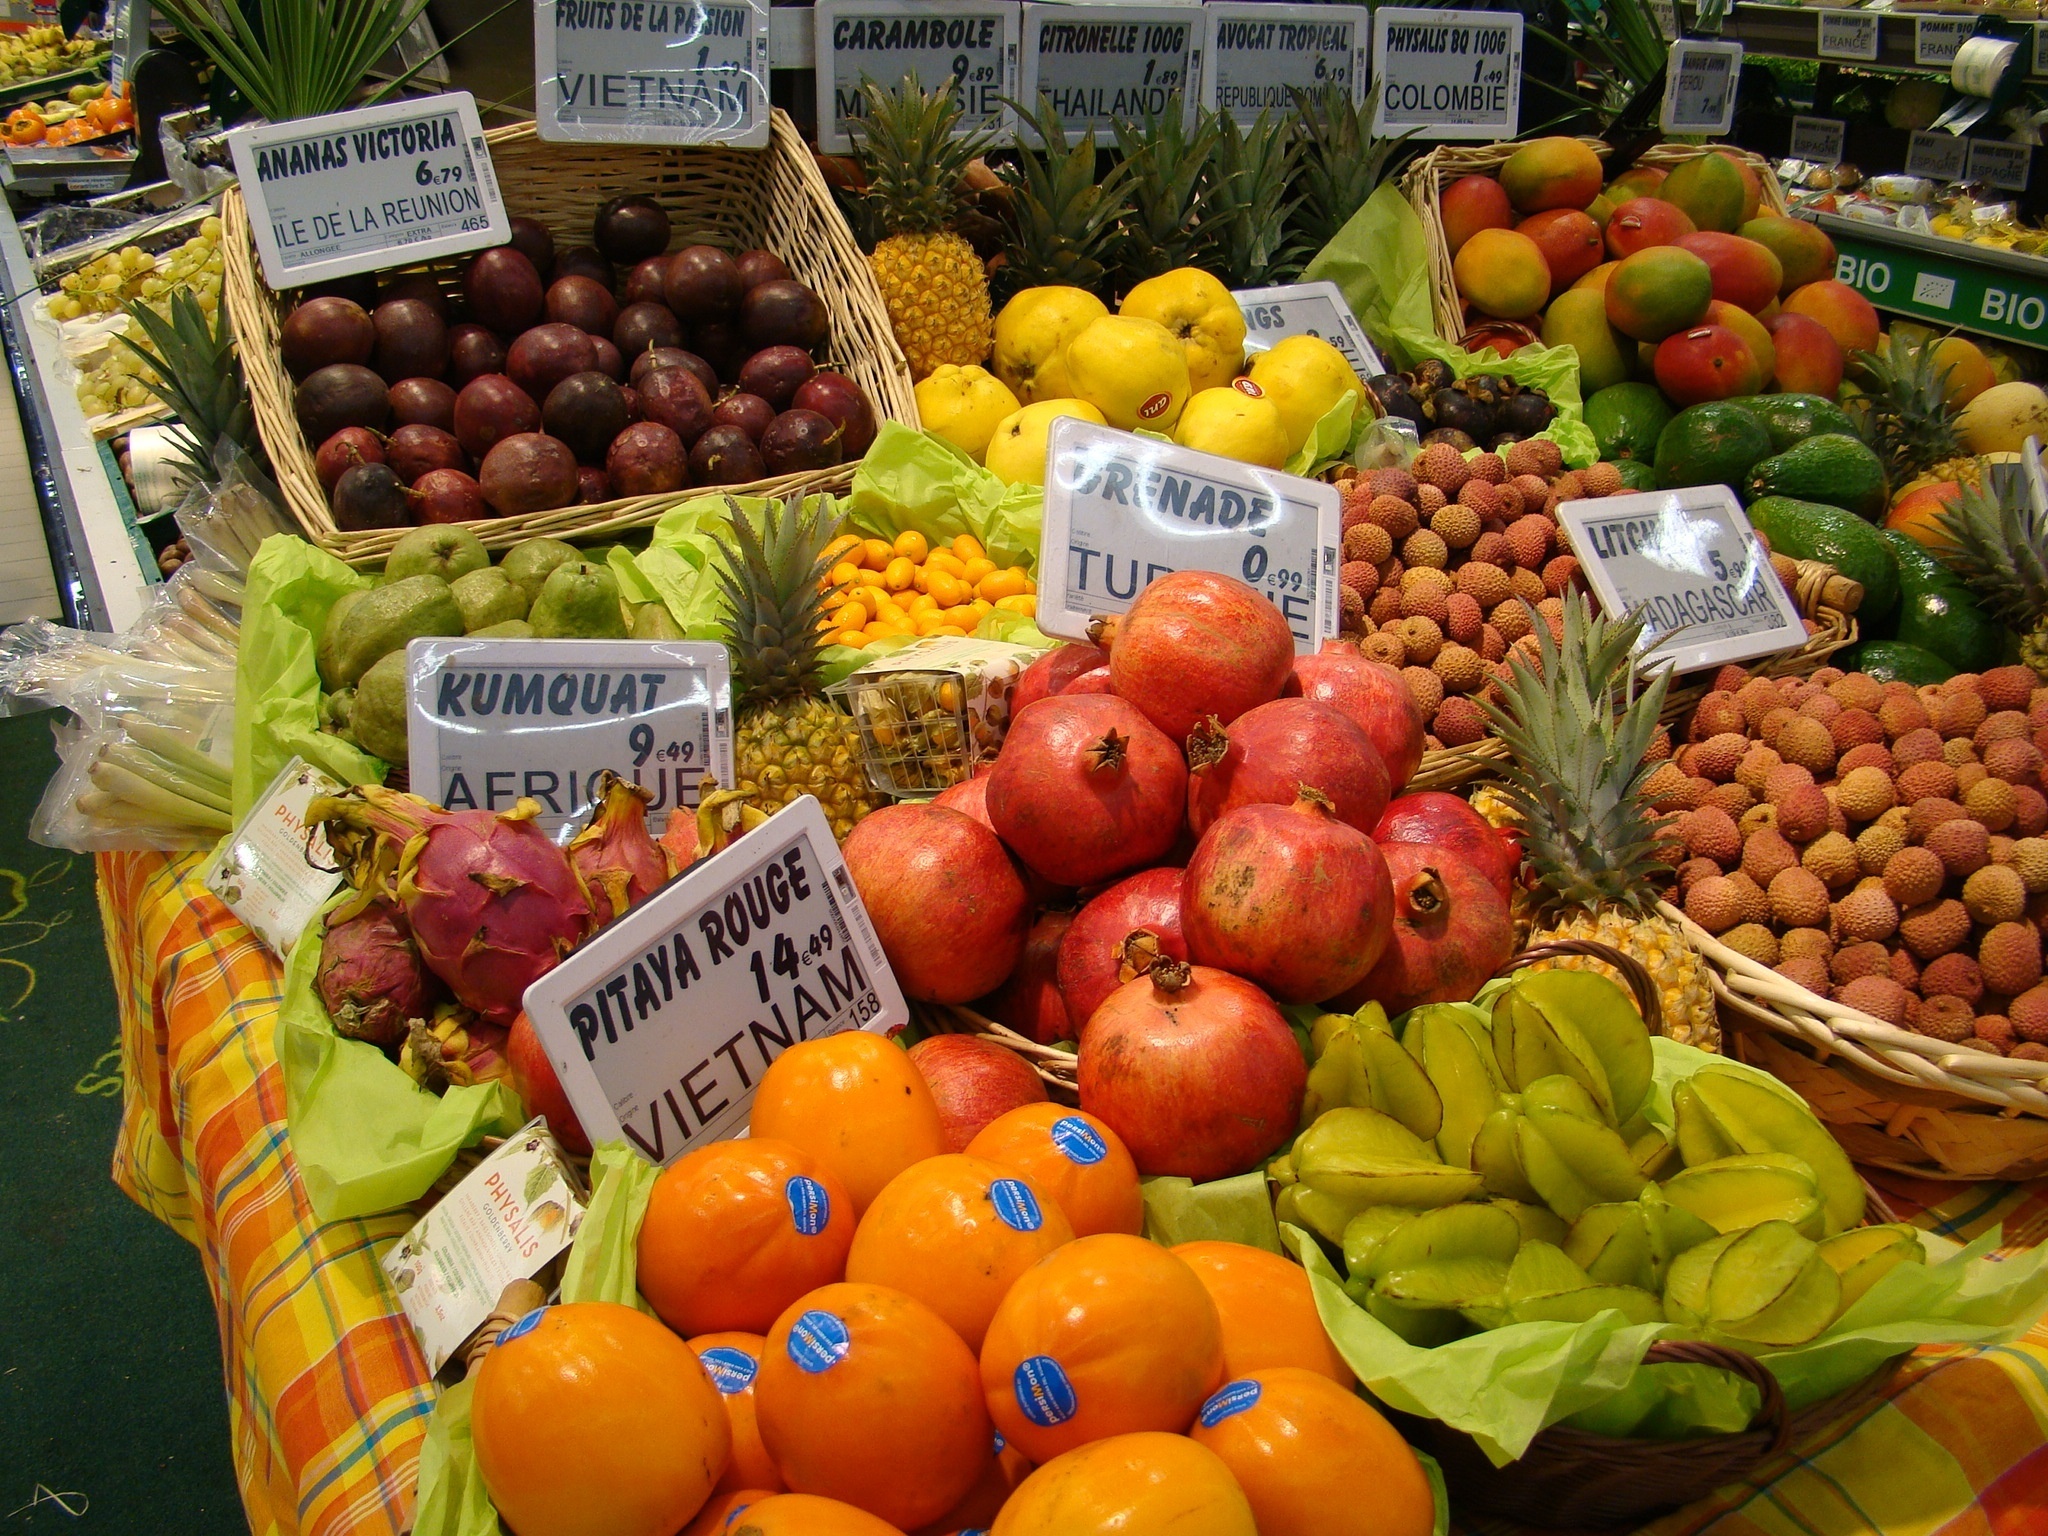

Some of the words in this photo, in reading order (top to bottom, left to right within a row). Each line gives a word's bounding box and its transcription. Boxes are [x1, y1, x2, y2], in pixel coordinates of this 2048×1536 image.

[556, 0, 616, 30] FRUITS
[620, 3, 644, 31] DE
[649, 5, 669, 33] LA
[674, 6, 745, 37] PASION
[833, 19, 996, 50] CARAMBOLE
[1920, 22, 1956, 33] POMME
[1957, 23, 1974, 34] BIO
[1039, 24, 1138, 53] CITRONELLE
[1141, 26, 1184, 54] 100G
[1217, 22, 1275, 51] AVOCAT
[1278, 24, 1347, 51] TROPICAL
[1387, 26, 1447, 54] PHYSALIS
[1472, 28, 1506, 55] 100G
[1822, 35, 1867, 49] FRANCE
[1920, 43, 1961, 55] FRANC
[557, 73, 748, 113] VIETNAM
[1216, 86, 1292, 109] REPUBLIQUE
[1384, 84, 1506, 111] COLOMBIE
[257, 136, 347, 183] ANANAS
[352, 117, 456, 164] VICTORIA
[1971, 165, 2022, 180] ESPAGNE
[273, 219, 309, 249] ILE
[349, 206, 379, 233] LA
[382, 185, 481, 227] REUNION
[406, 226, 432, 237] EXTRA
[461, 215, 489, 232] 465
[300, 245, 341, 259] ALLONGEE
[1835, 254, 1891, 293] BIO
[1245, 305, 1285, 330] NGS
[1980, 288, 2046, 331] BIO
[1073, 461, 1274, 538] GRENADE
[437, 672, 666, 717] KUMQUAT
[443, 767, 706, 814] AFRIQUE
[570, 933, 701, 1062] PITAYA
[699, 847, 812, 966] ROUGE
[849, 992, 880, 1028] 158
[622, 946, 867, 1165] VIETNAM
[482, 1202, 513, 1254] GOLDENBERRY
[484, 1171, 539, 1258] PHYSALIS
